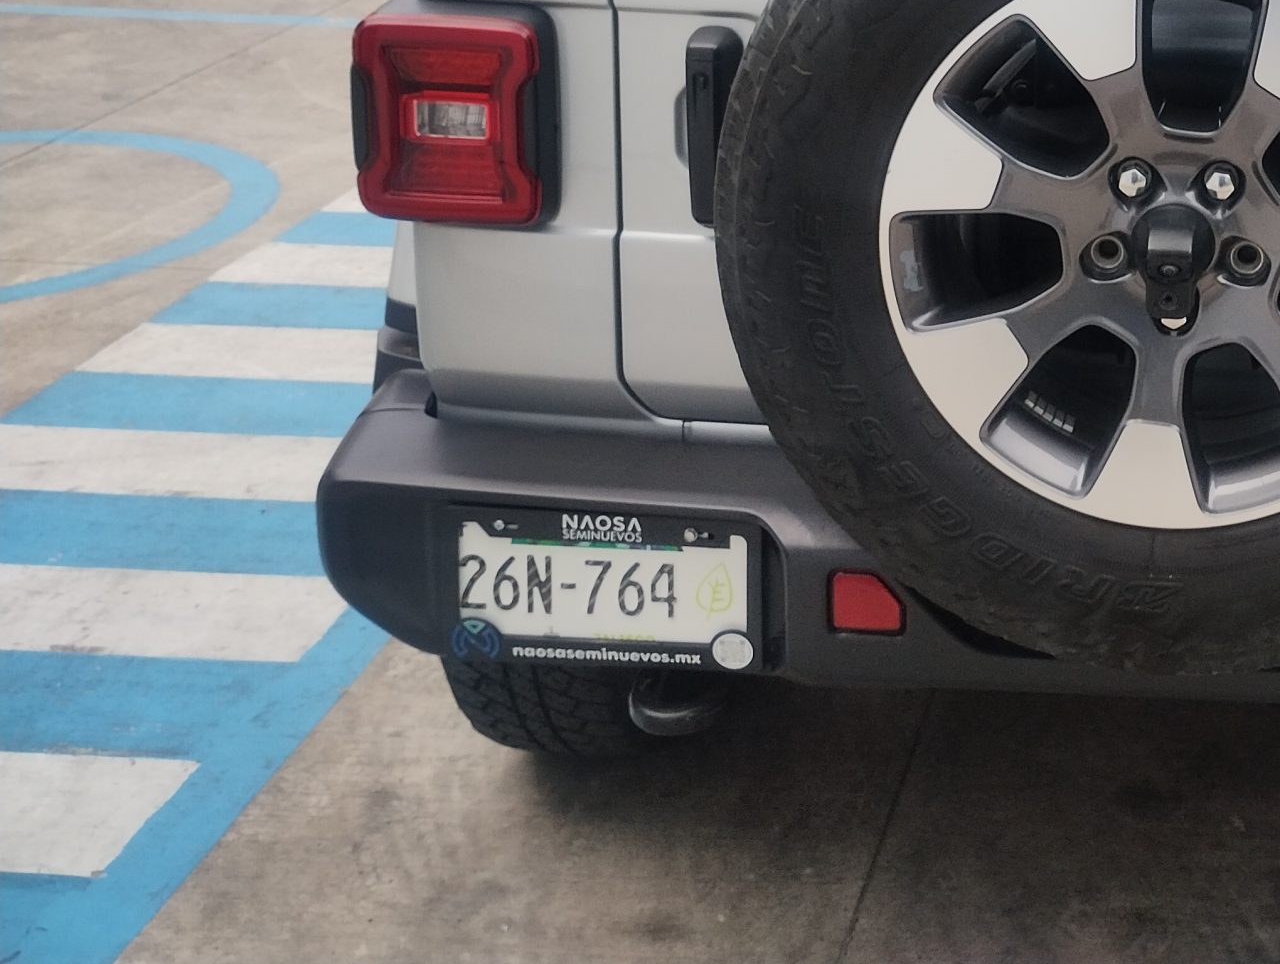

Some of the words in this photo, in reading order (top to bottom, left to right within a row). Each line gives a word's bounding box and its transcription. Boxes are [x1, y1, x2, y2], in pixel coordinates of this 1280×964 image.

[793, 202, 1184, 614] BRIDGESTONE
[561, 513, 642, 532] NAOSA
[562, 528, 643, 543] SEMINUEVOS
[458, 553, 678, 619] 26N-764
[511, 645, 702, 665] naosaseminuevos.mx
